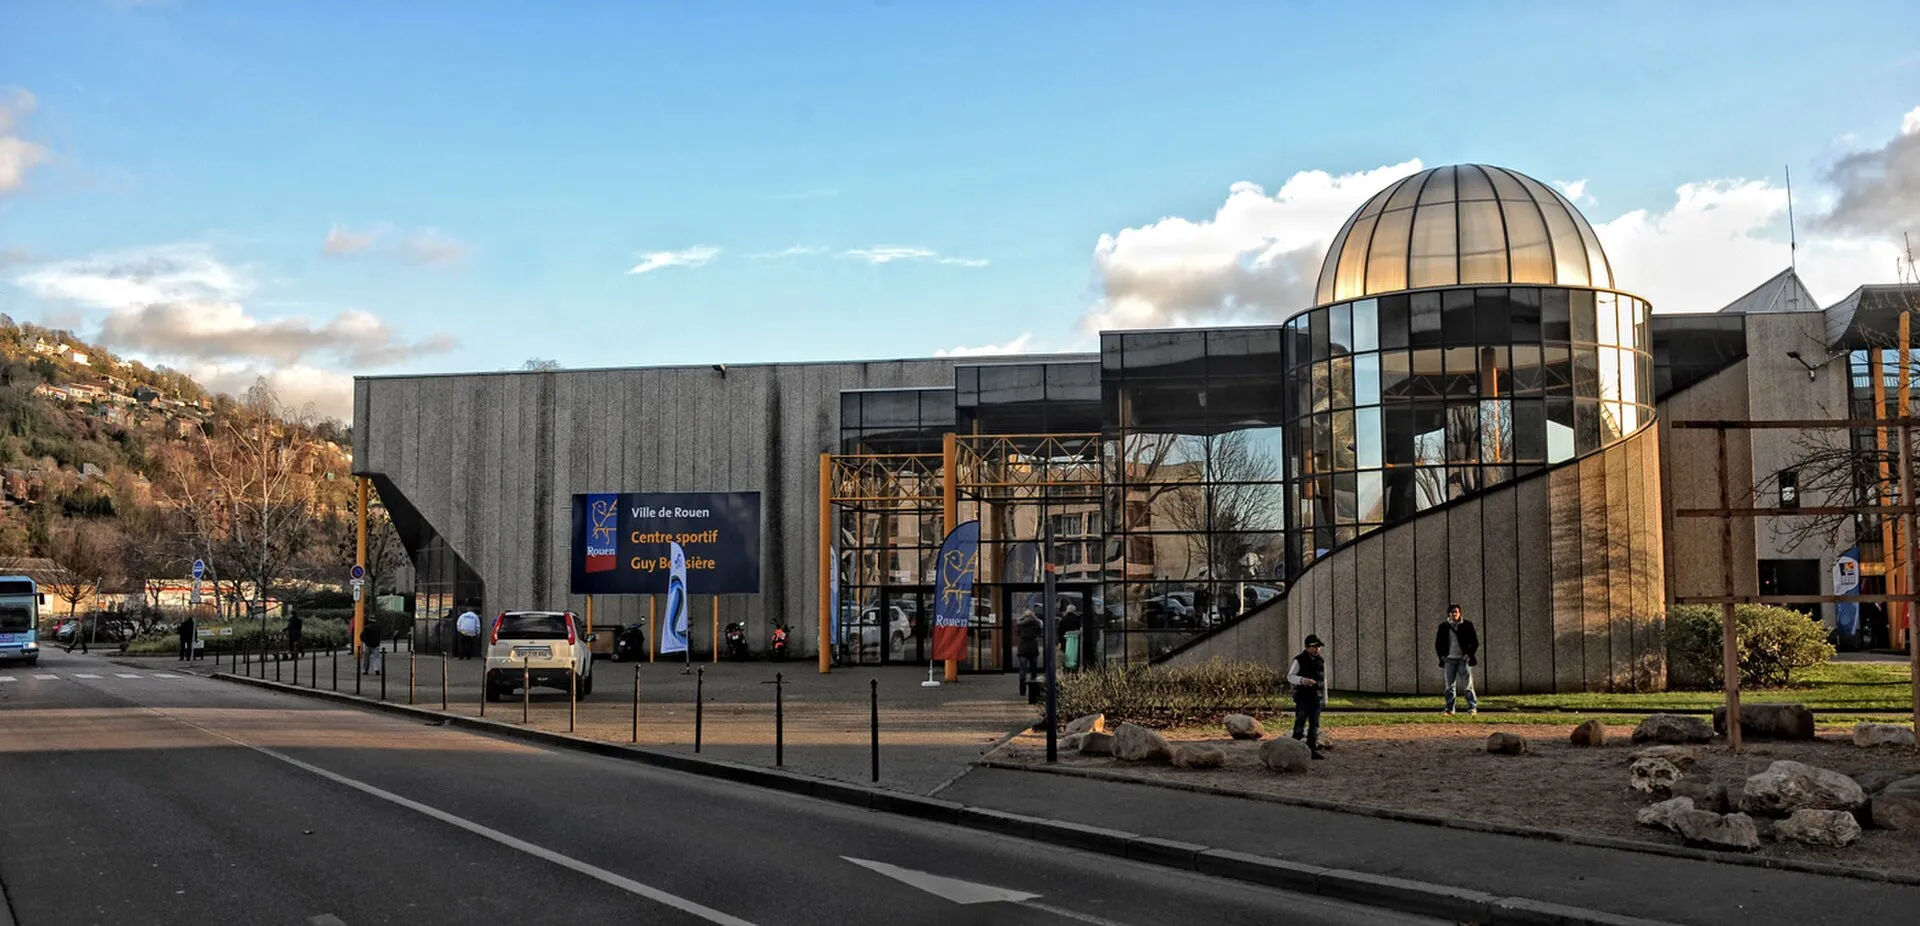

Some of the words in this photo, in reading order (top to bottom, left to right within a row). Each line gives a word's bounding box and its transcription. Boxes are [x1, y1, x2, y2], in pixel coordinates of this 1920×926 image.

[631, 507, 656, 518] Ville
[658, 507, 672, 518] de
[674, 507, 710, 518] Rouen
[631, 530, 672, 543] Centre
[675, 529, 719, 547] sportif
[587, 546, 616, 557] Rouen
[630, 556, 657, 573] Guy
[659, 556, 716, 569] Bsière
[936, 614, 968, 629] Rouen
